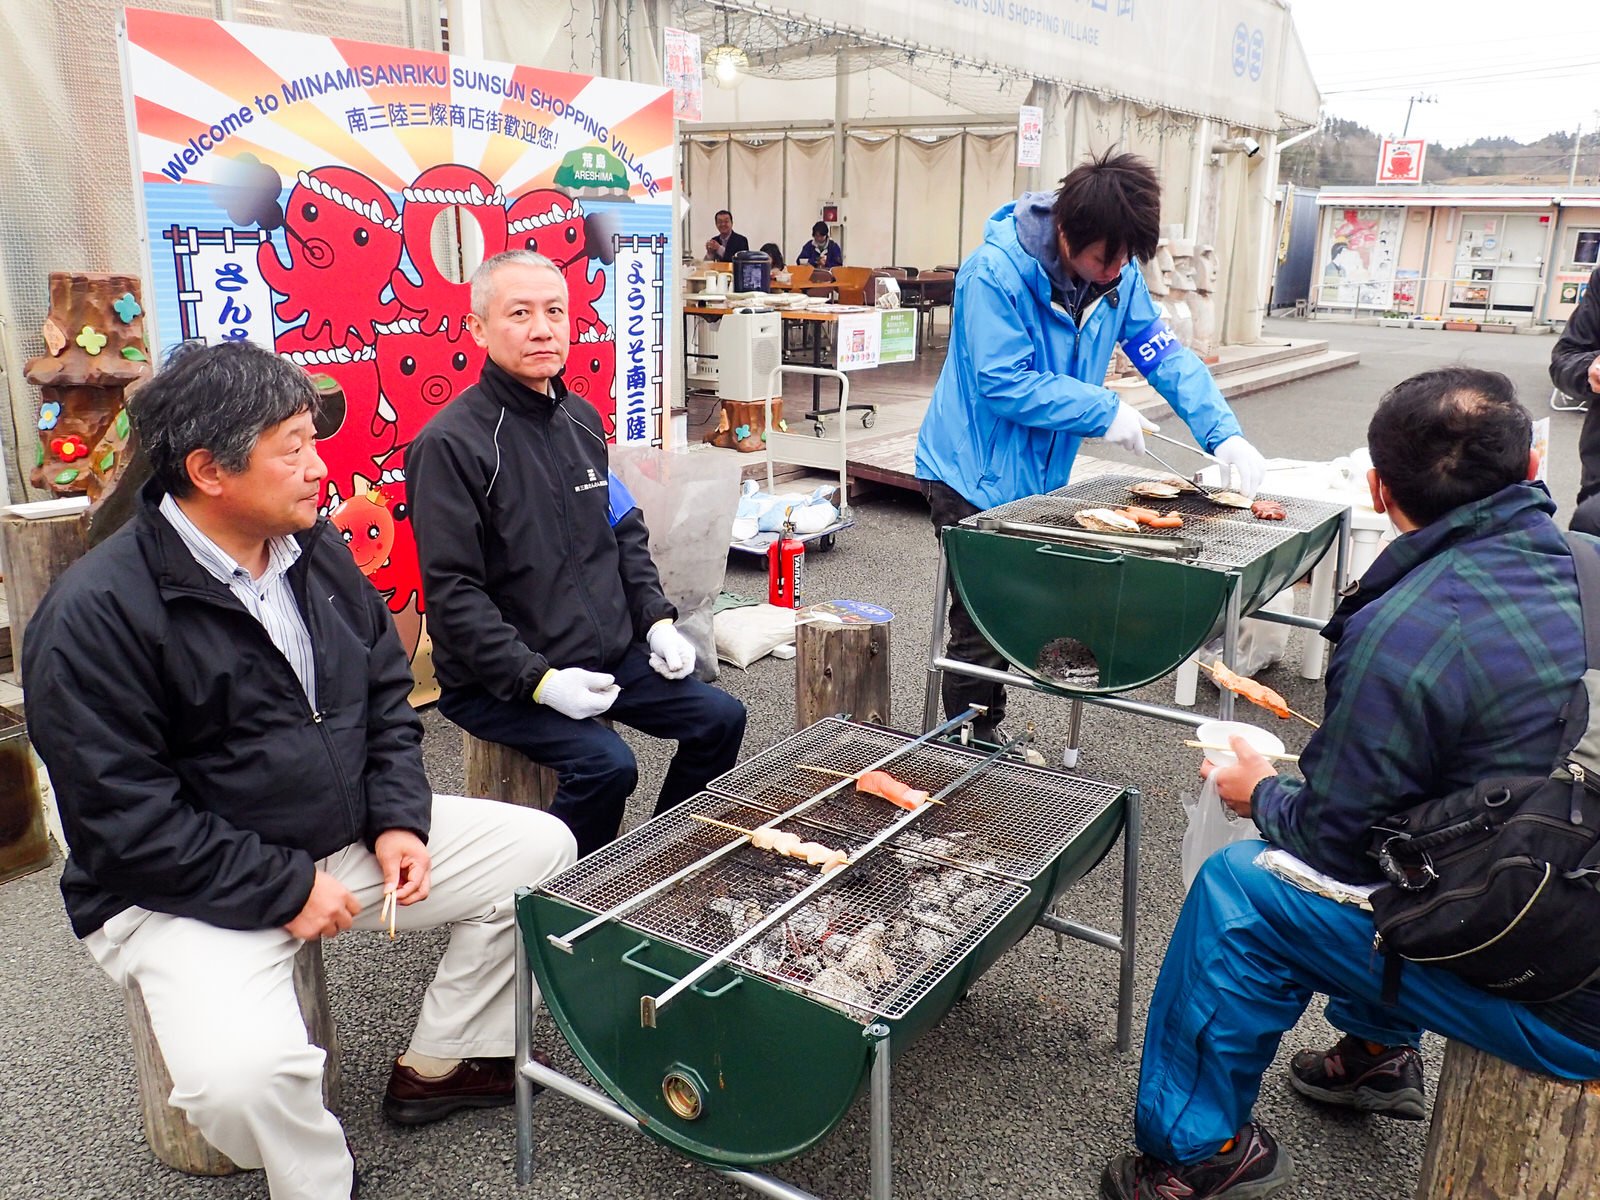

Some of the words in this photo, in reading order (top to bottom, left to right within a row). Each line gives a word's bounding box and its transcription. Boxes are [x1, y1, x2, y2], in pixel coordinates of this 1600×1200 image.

[1008, 2, 1059, 34] SHOPPING
[1062, 19, 1100, 46] VILLAGE
[161, 105, 255, 183] Welcome
[254, 94, 279, 116] to
[281, 64, 448, 105] MINAMISANRIKU
[452, 67, 526, 102] SUNSUN
[530, 87, 610, 144] SHOPPING
[611, 134, 660, 199] VILLAGE
[574, 169, 614, 182] ARESHIMA
[626, 259, 647, 442] ようこそ南三陸
